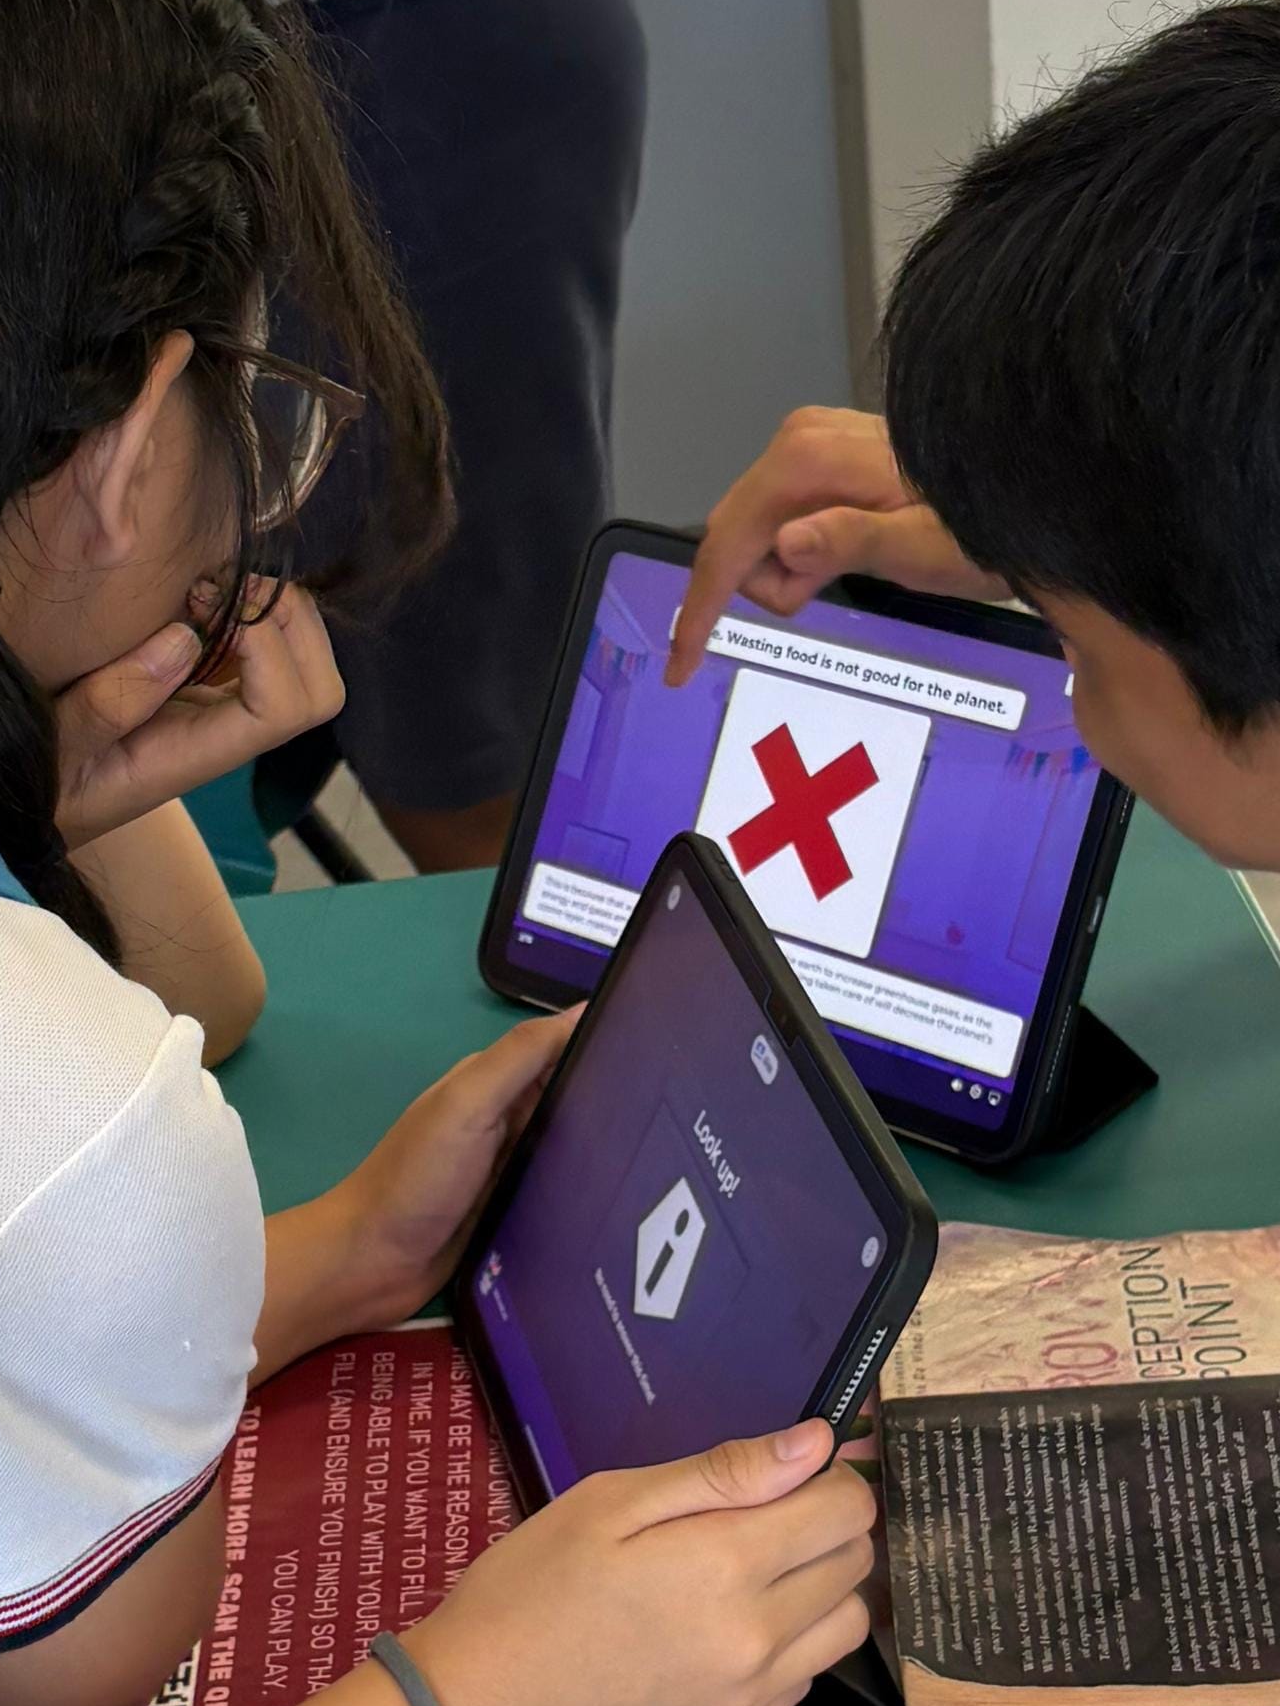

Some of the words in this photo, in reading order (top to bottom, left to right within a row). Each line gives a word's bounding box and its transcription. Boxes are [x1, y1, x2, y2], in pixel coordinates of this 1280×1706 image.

[724, 629, 783, 658] Wasting
[785, 644, 818, 665] food
[819, 653, 834, 669] is
[834, 658, 860, 676] not
[861, 664, 901, 689] good
[902, 675, 925, 693] for
[925, 681, 953, 701] the
[953, 688, 1008, 718] planet.
[694, 1110, 722, 1168] Look
[717, 1159, 741, 1198] up!
[1120, 1246, 1186, 1380] CEPTION
[331, 1351, 355, 1387] FILL
[370, 1351, 394, 1401] BEING
[411, 1362, 434, 1379] IN
[449, 1348, 472, 1380] HIS
[324, 1388, 354, 1431] (AND
[409, 1380, 433, 1426] TIME.
[448, 1384, 472, 1419] MAY
[366, 1404, 392, 1449] ABLE
[408, 1429, 431, 1445] IF
[448, 1425, 471, 1447] BE
[229, 1433, 260, 1501] LEARN
[322, 1433, 349, 1505] ENSURE
[365, 1451, 389, 1474] TO
[406, 1448, 430, 1484] YOU
[447, 1450, 470, 1486] THE
[362, 1479, 387, 1524] PLAY
[403, 1487, 428, 1539] WANT
[487, 1479, 511, 1534] ONLY
[319, 1507, 344, 1547] YOU
[444, 1489, 469, 1563] REASON
[271, 1548, 299, 1590] YOU
[359, 1528, 384, 1575] WITH
[401, 1542, 425, 1570] TO
[214, 1570, 244, 1632] SCAN
[308, 1549, 342, 1620] FINISH)
[355, 1578, 381, 1634] YOUR
[399, 1573, 423, 1613] FILL
[267, 1592, 295, 1635] CAN
[207, 1634, 236, 1683] THE
[310, 1623, 334, 1650] SO
[261, 1639, 291, 1697] PLAY.
[306, 1651, 332, 1695] THA
